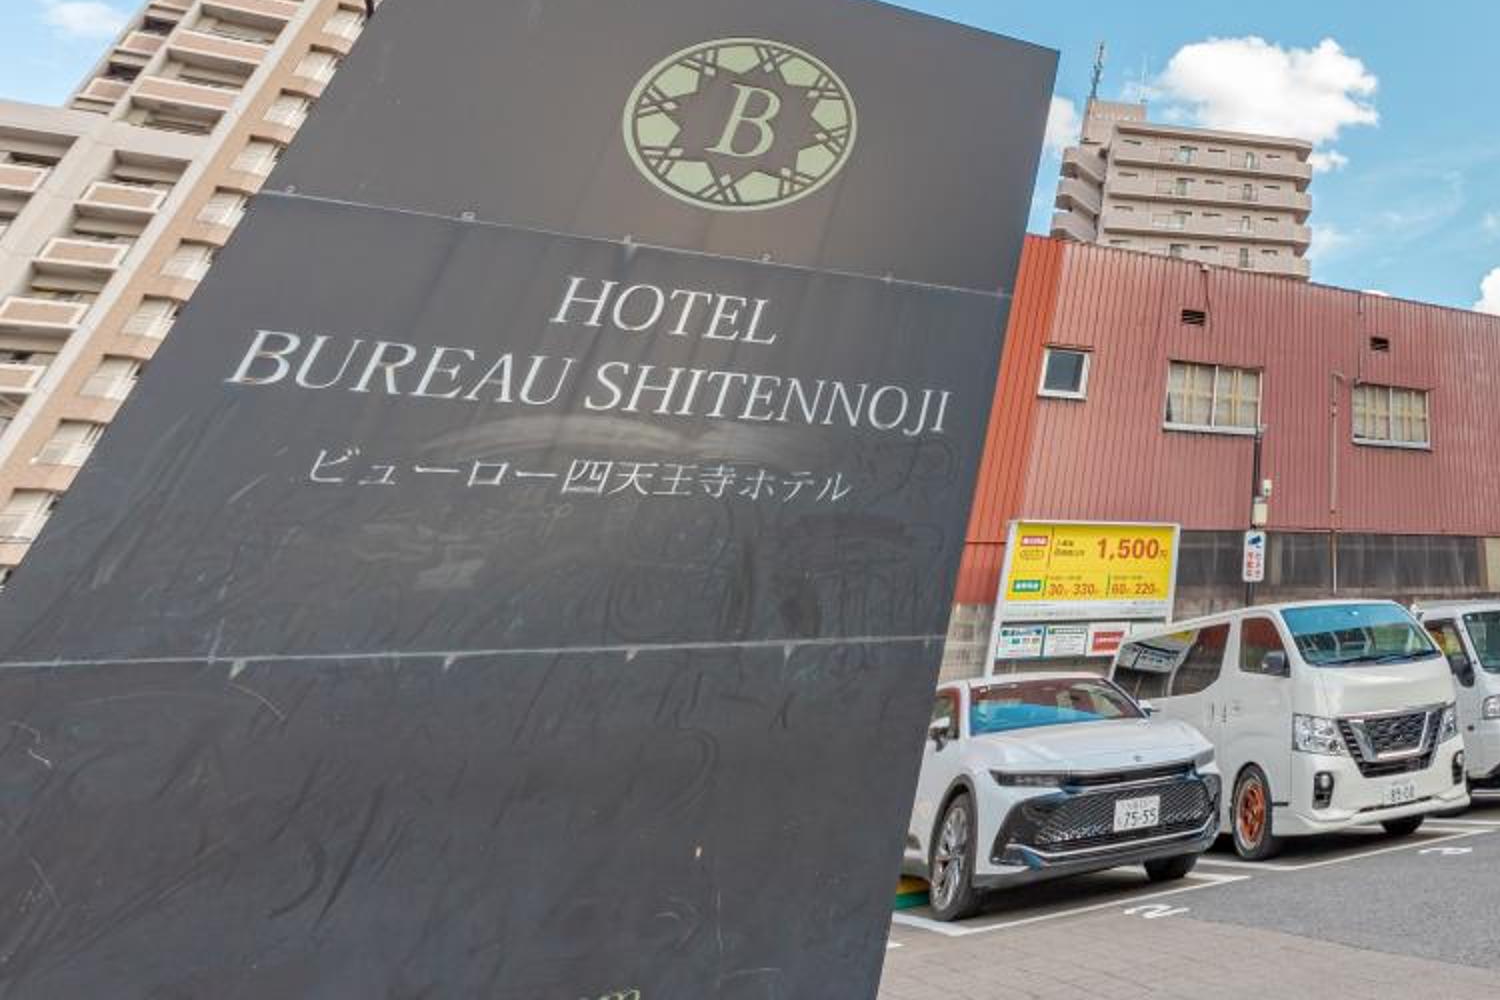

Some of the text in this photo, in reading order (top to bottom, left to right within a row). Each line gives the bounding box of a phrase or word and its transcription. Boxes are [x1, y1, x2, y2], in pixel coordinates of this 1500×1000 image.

[703, 82, 782, 158] B
[549, 276, 779, 346] HOTEL
[223, 328, 956, 436] BUREAU SHITENNOJI
[308, 448, 854, 502] ビューロー四天王寺ホテル
